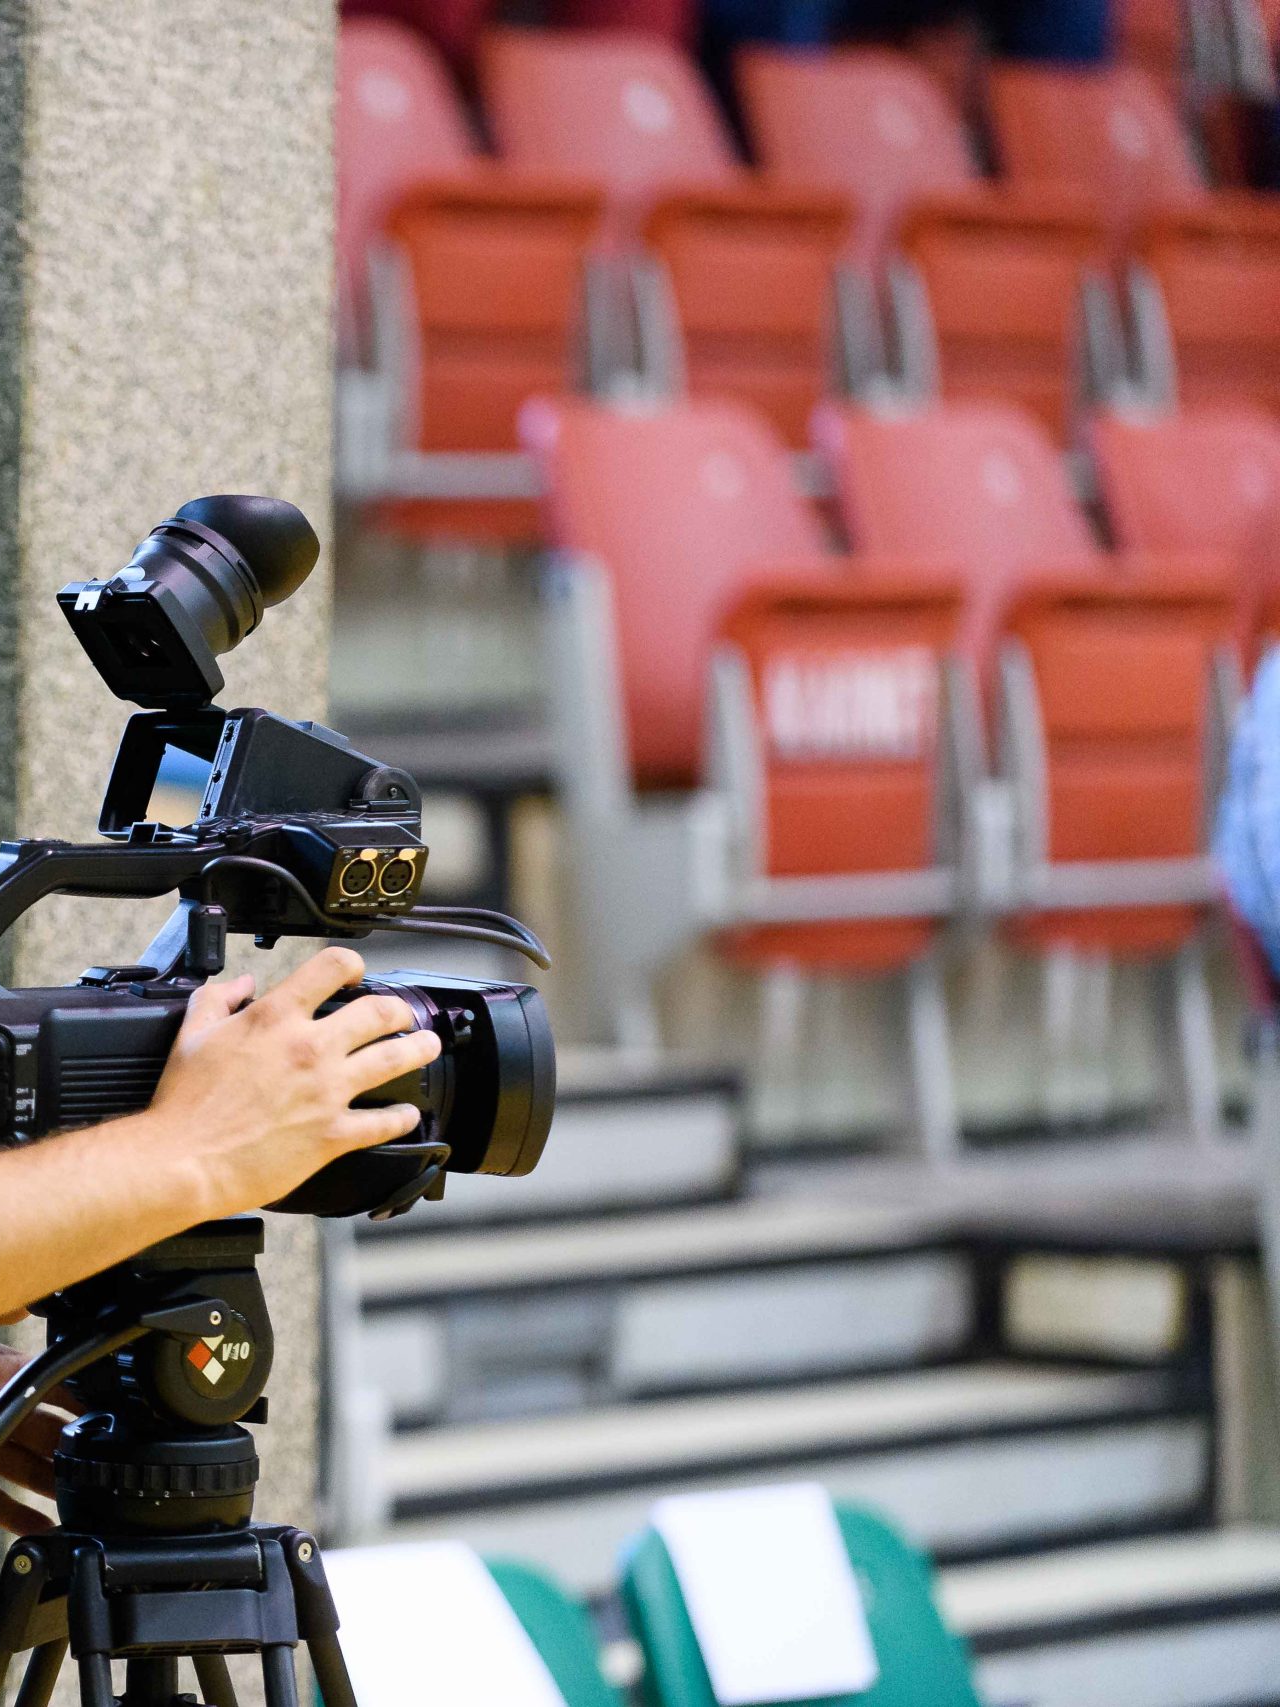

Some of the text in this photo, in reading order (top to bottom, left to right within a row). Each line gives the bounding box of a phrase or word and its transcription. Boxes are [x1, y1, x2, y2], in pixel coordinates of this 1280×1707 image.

[222, 1342, 250, 1361] V10
[164, 1490, 170, 1498] 2
[190, 1490, 195, 1498] 1
